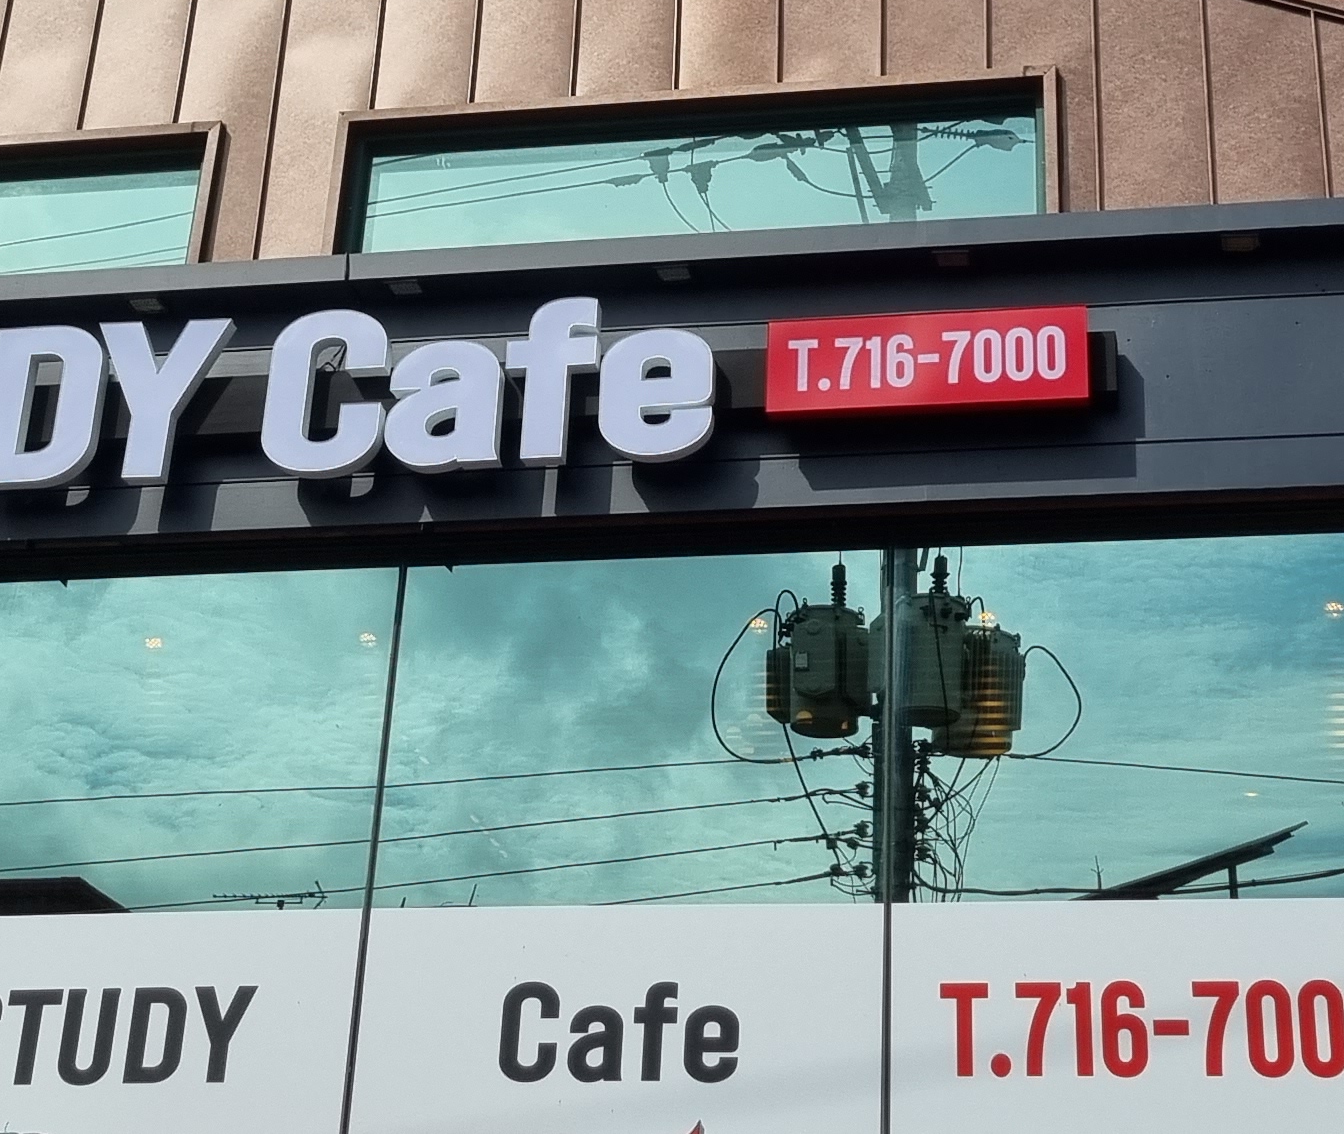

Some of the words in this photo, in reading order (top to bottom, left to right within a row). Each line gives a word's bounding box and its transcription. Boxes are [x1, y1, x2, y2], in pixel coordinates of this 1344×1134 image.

[261, 296, 716, 478] Cafe
[788, 325, 1068, 392] T.716-7000
[498, 981, 740, 1082] Cafe
